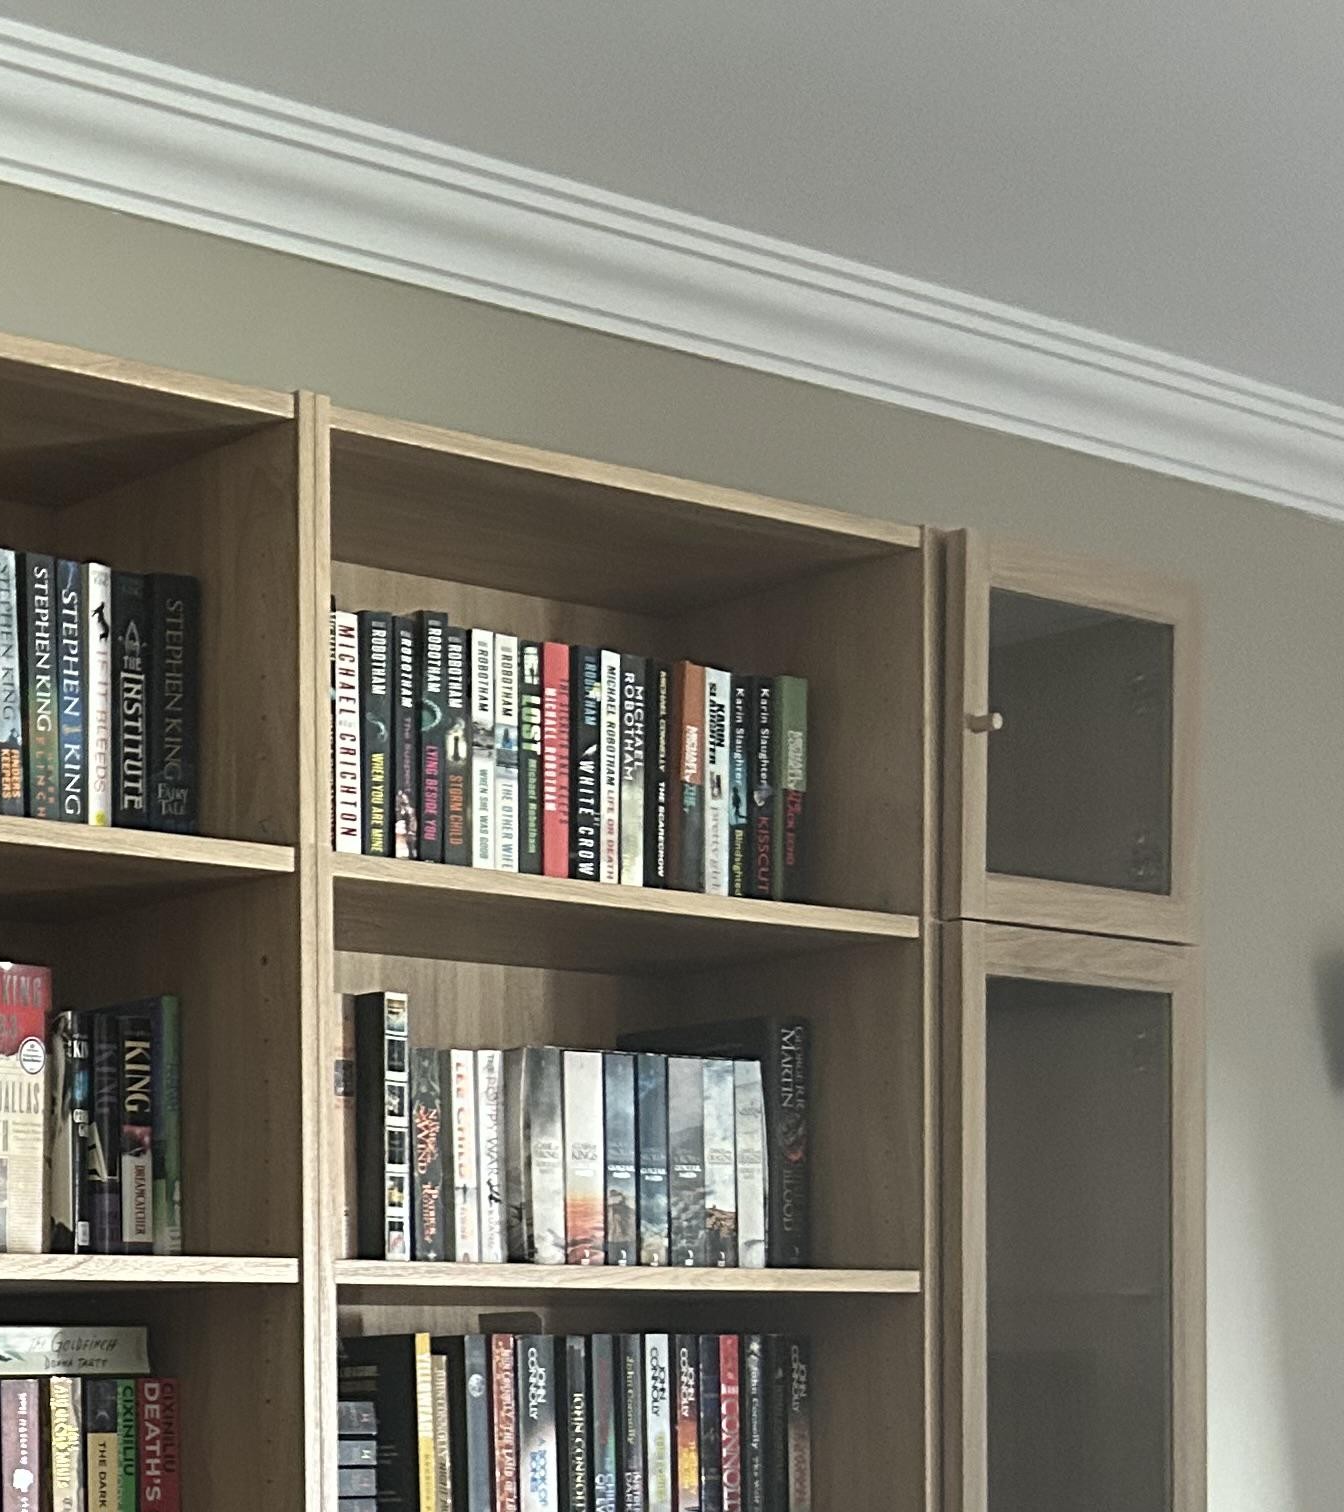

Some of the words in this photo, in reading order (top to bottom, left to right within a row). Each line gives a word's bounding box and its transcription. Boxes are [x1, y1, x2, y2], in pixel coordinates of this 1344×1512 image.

[62, 591, 79, 717] STEPHEN
[339, 626, 356, 711] MICHAEL
[372, 629, 385, 694] ROBOTHAM
[428, 627, 442, 692] ROBOTHAM
[449, 643, 463, 709] ROBOTHAM
[624, 672, 633, 781] ROBOTHAM
[634, 686, 644, 767] MICHAEL
[65, 743, 80, 816] KING
[341, 735, 357, 836] CRICHTON
[580, 760, 594, 814] WHITE
[579, 827, 593, 875] CROW
[124, 1039, 150, 1112] KING
[781, 1029, 793, 1108] MARTIN
[144, 1383, 160, 1506] DEATH'S
